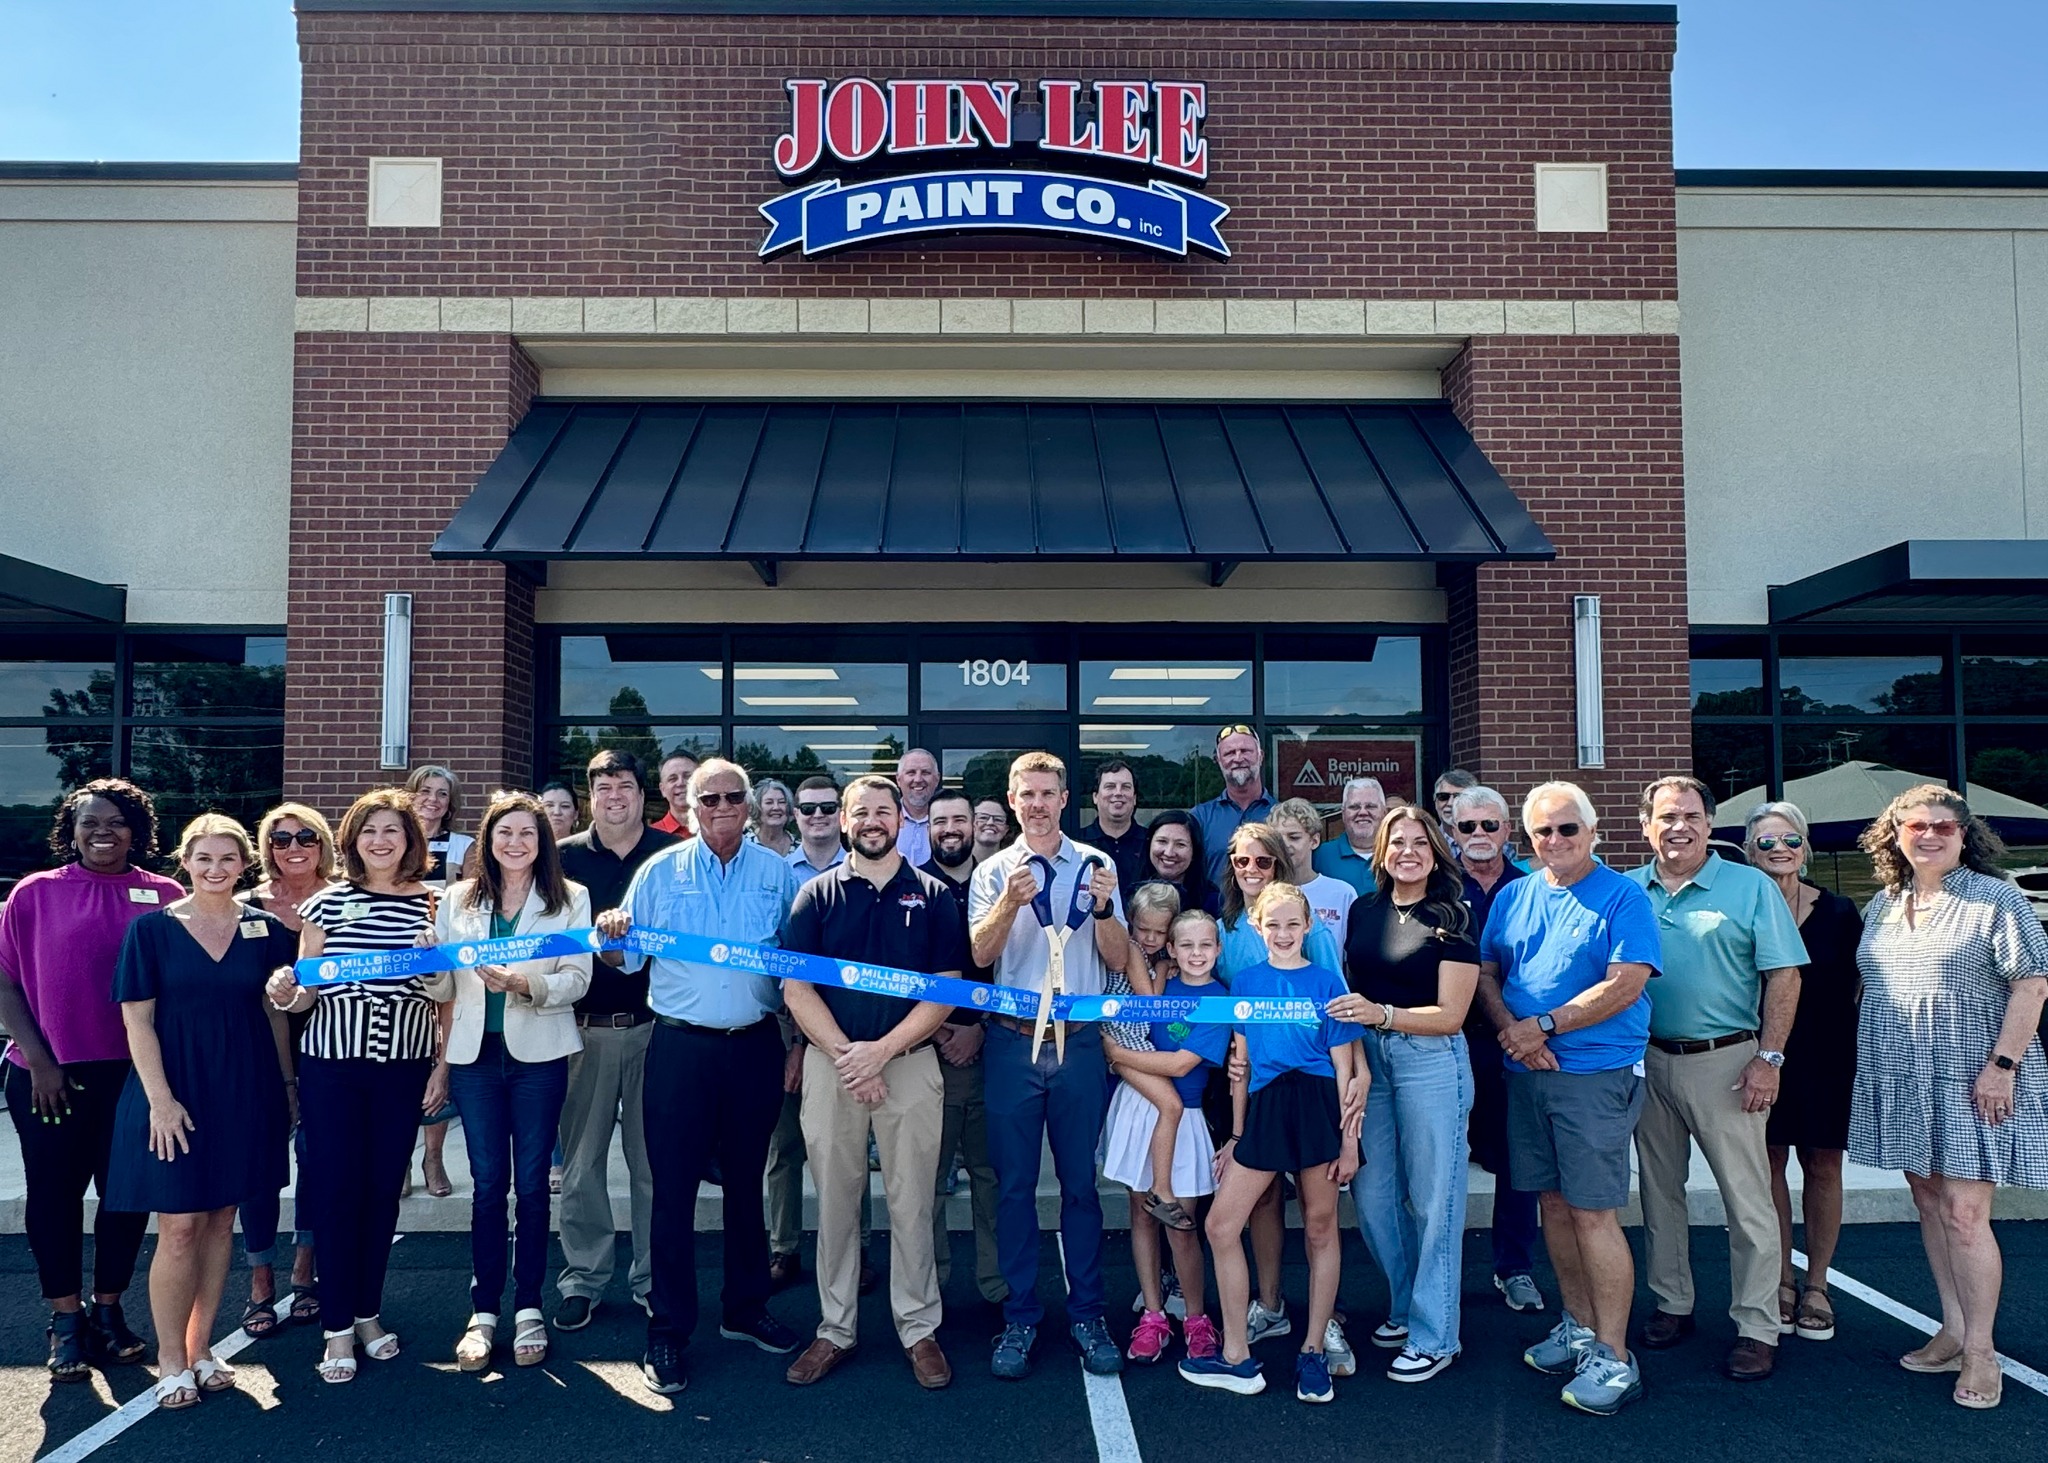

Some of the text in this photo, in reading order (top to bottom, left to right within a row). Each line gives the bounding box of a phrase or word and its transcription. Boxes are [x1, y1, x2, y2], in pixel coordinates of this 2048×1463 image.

[774, 77, 1207, 179] JOHN LEE
[846, 180, 1163, 237] PAINT CO. inc
[958, 659, 1030, 686] 1804
[1328, 757, 1400, 775] Benjamin
[477, 936, 554, 953] MILLBROOK
[340, 952, 422, 969] MILLBROOK
[479, 946, 545, 963] CHAMBER
[731, 945, 807, 967] MILLBROOK
[340, 962, 411, 979] CHAMBER
[729, 956, 795, 974] CHAMBER
[859, 977, 926, 996] CHAMBER
[861, 967, 938, 989] MILLBROOK
[1121, 999, 1200, 1009] MILLBROOK
[1121, 1009, 1187, 1019] CHAMBER
